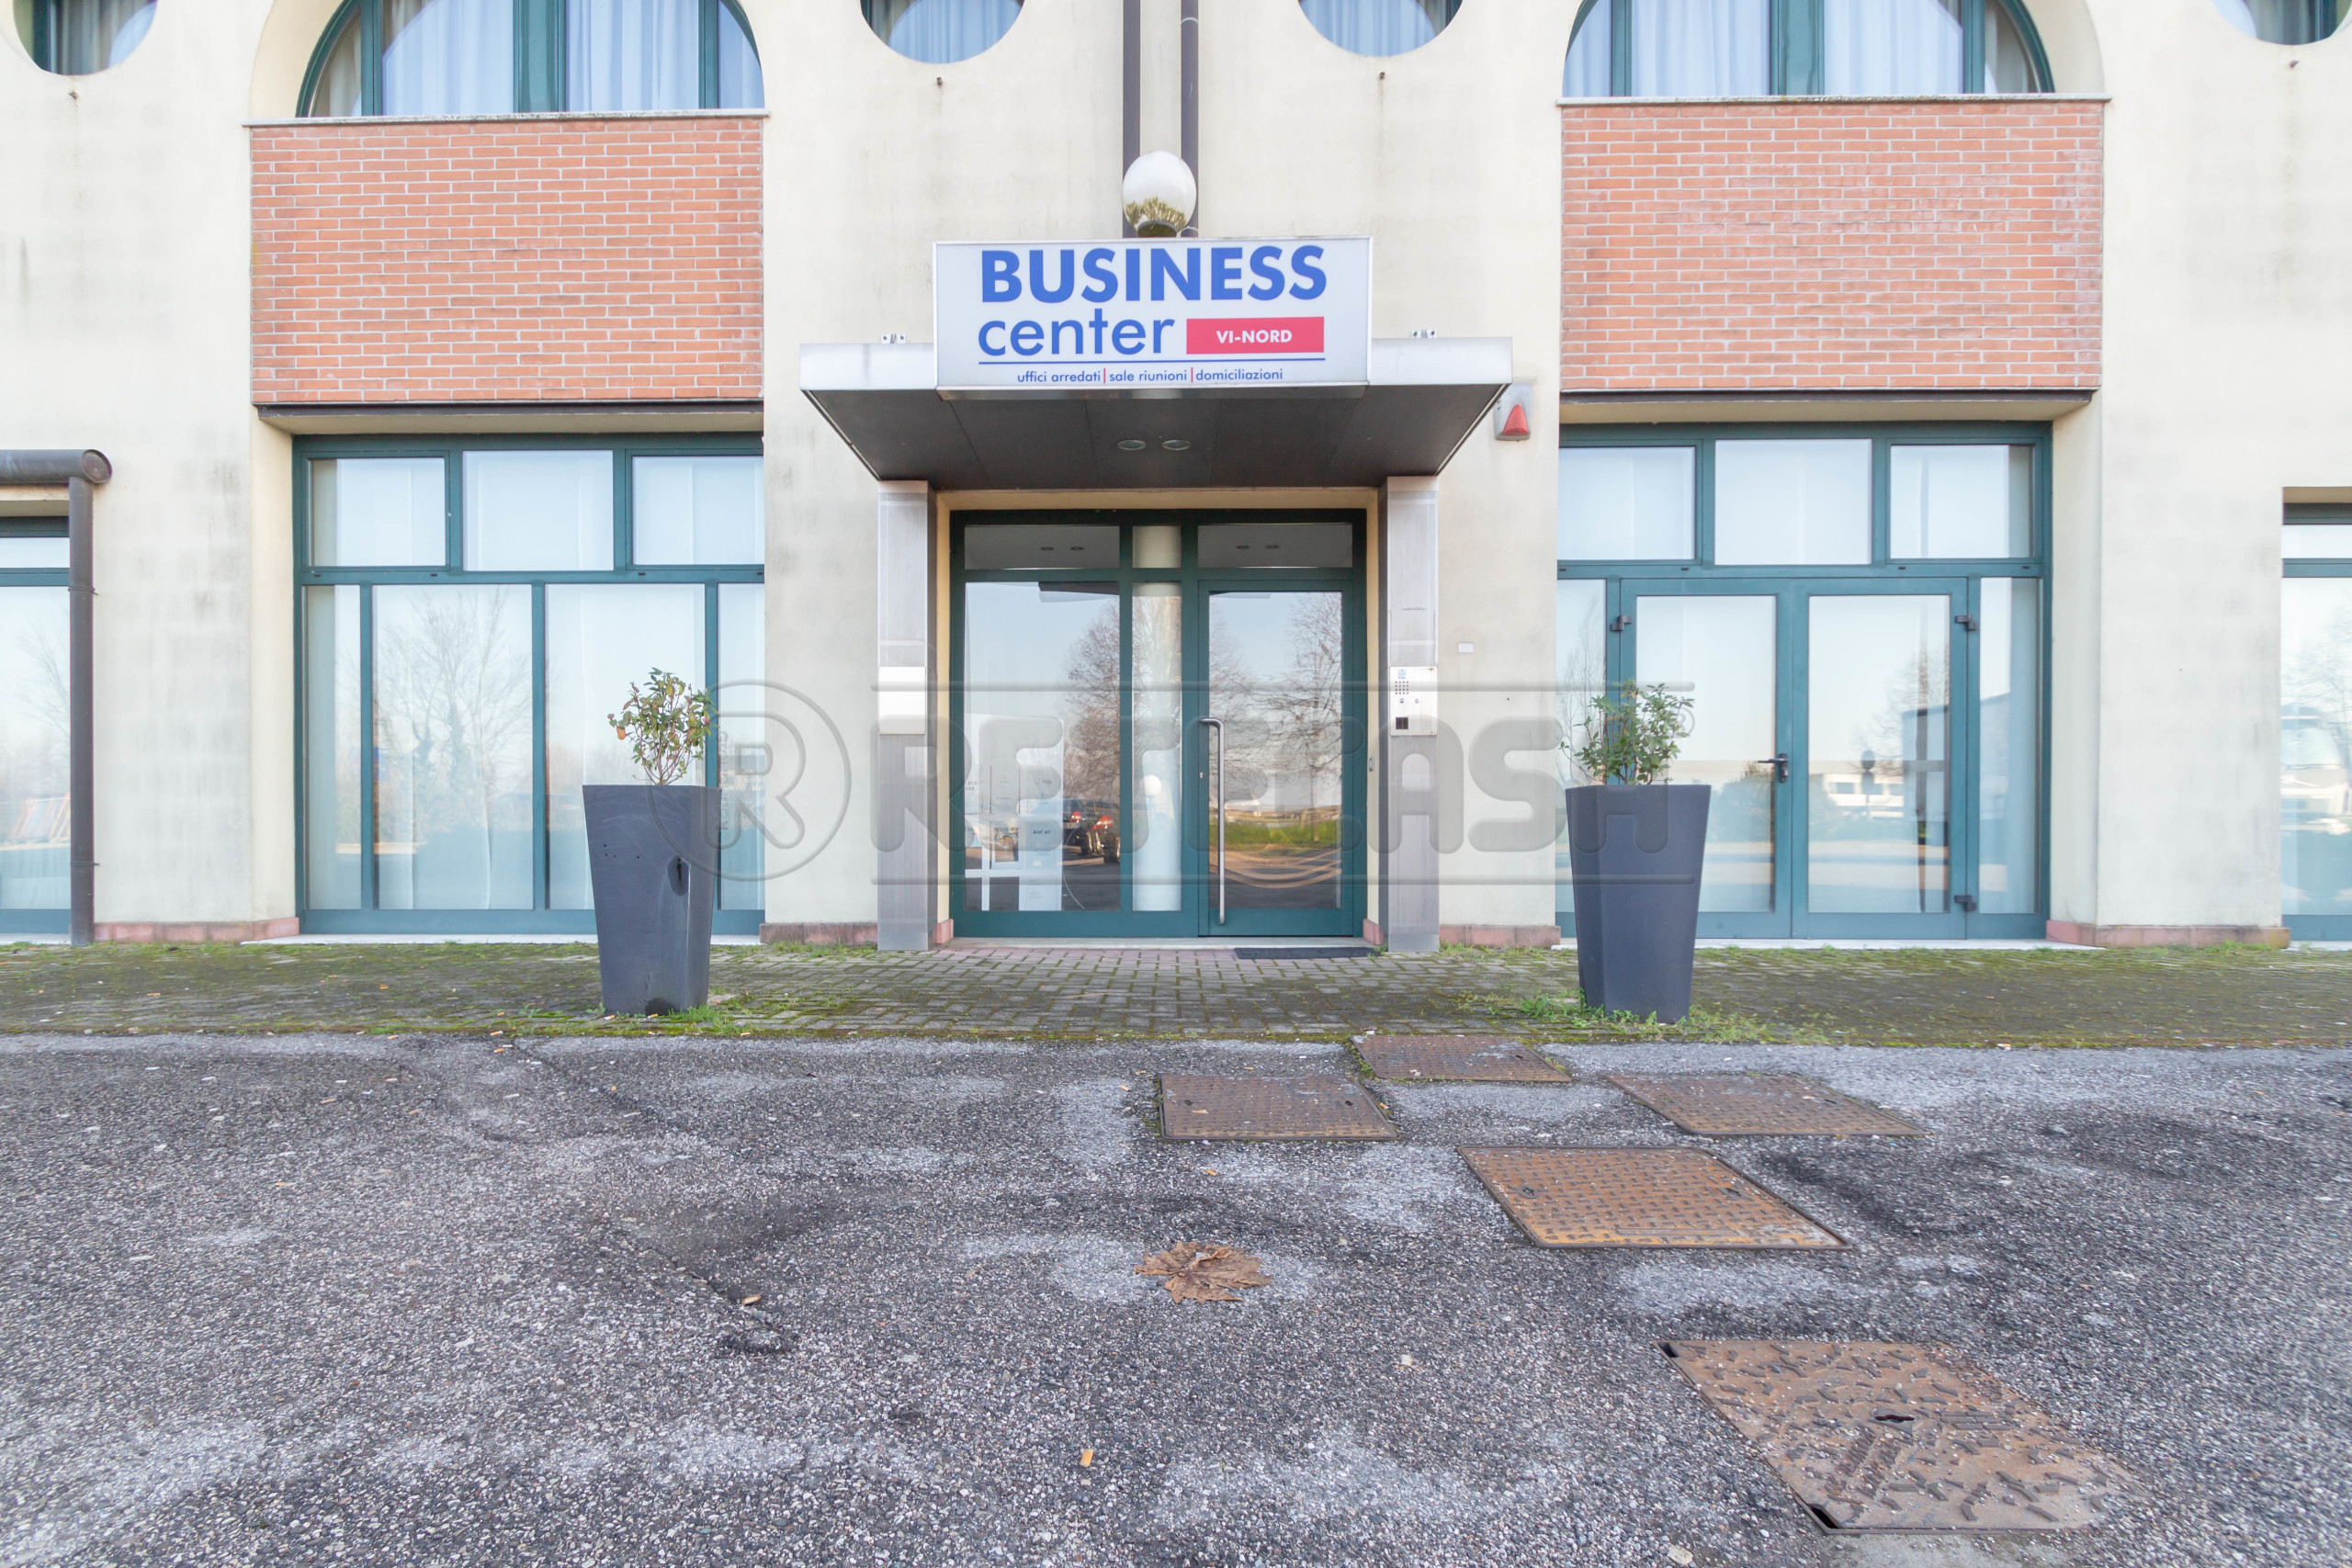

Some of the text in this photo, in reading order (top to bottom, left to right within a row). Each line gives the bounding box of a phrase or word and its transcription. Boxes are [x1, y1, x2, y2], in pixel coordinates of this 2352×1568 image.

[981, 244, 1328, 303] BUSINESS
[978, 308, 1175, 356] center
[1216, 329, 1293, 344] VI-NORD
[1017, 366, 1283, 382] uffici arredati sale riunioni domiciliazioni
